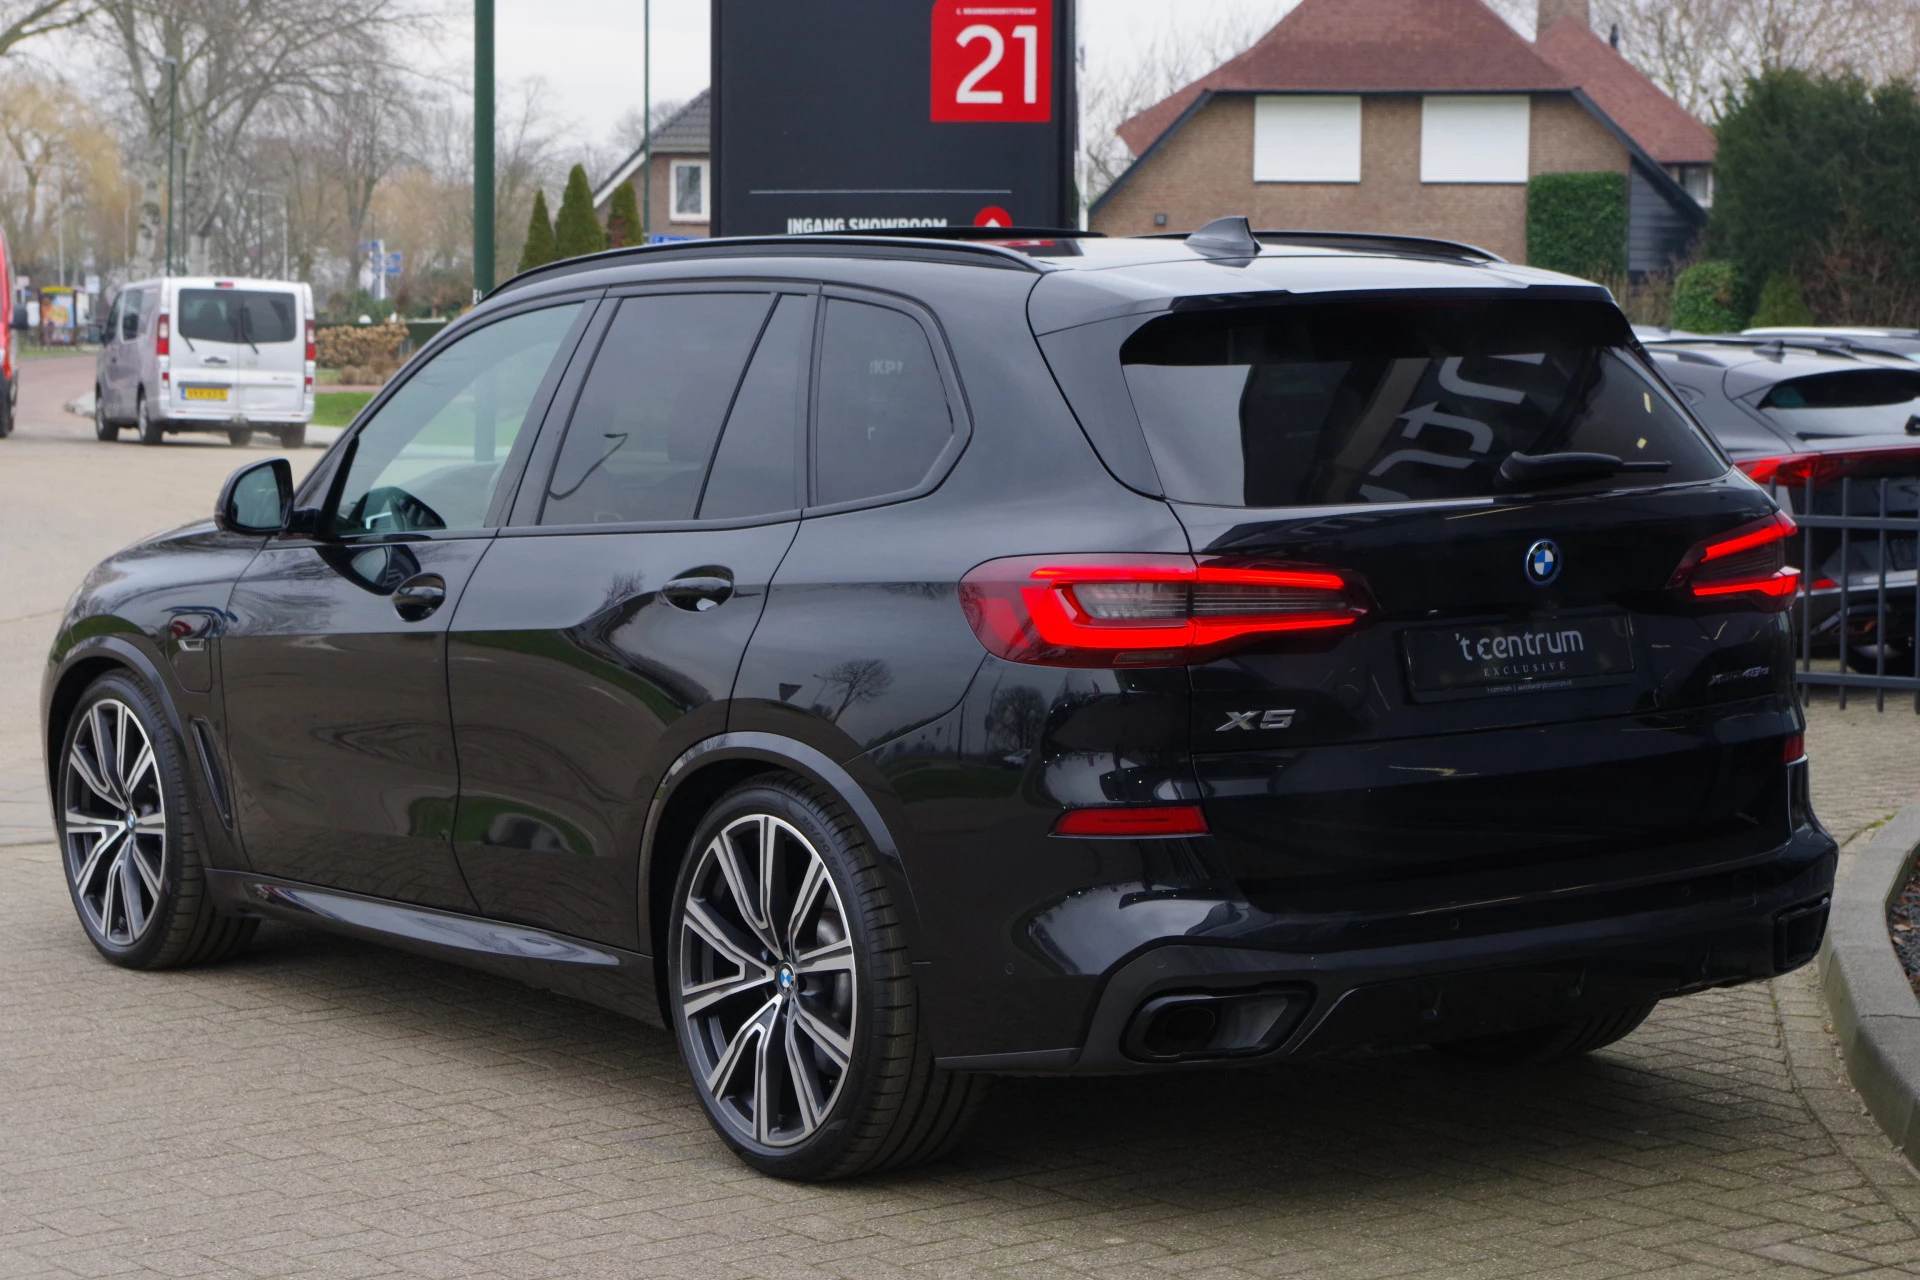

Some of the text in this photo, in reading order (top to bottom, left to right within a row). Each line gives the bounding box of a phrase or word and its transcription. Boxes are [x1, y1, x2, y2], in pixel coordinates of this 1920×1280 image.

[955, 24, 1038, 104] 21
[787, 218, 845, 235] INGANG
[1476, 630, 1585, 661] centrum
[1483, 661, 1567, 677] EXCLUSIVE
[1214, 709, 1297, 732] X5
